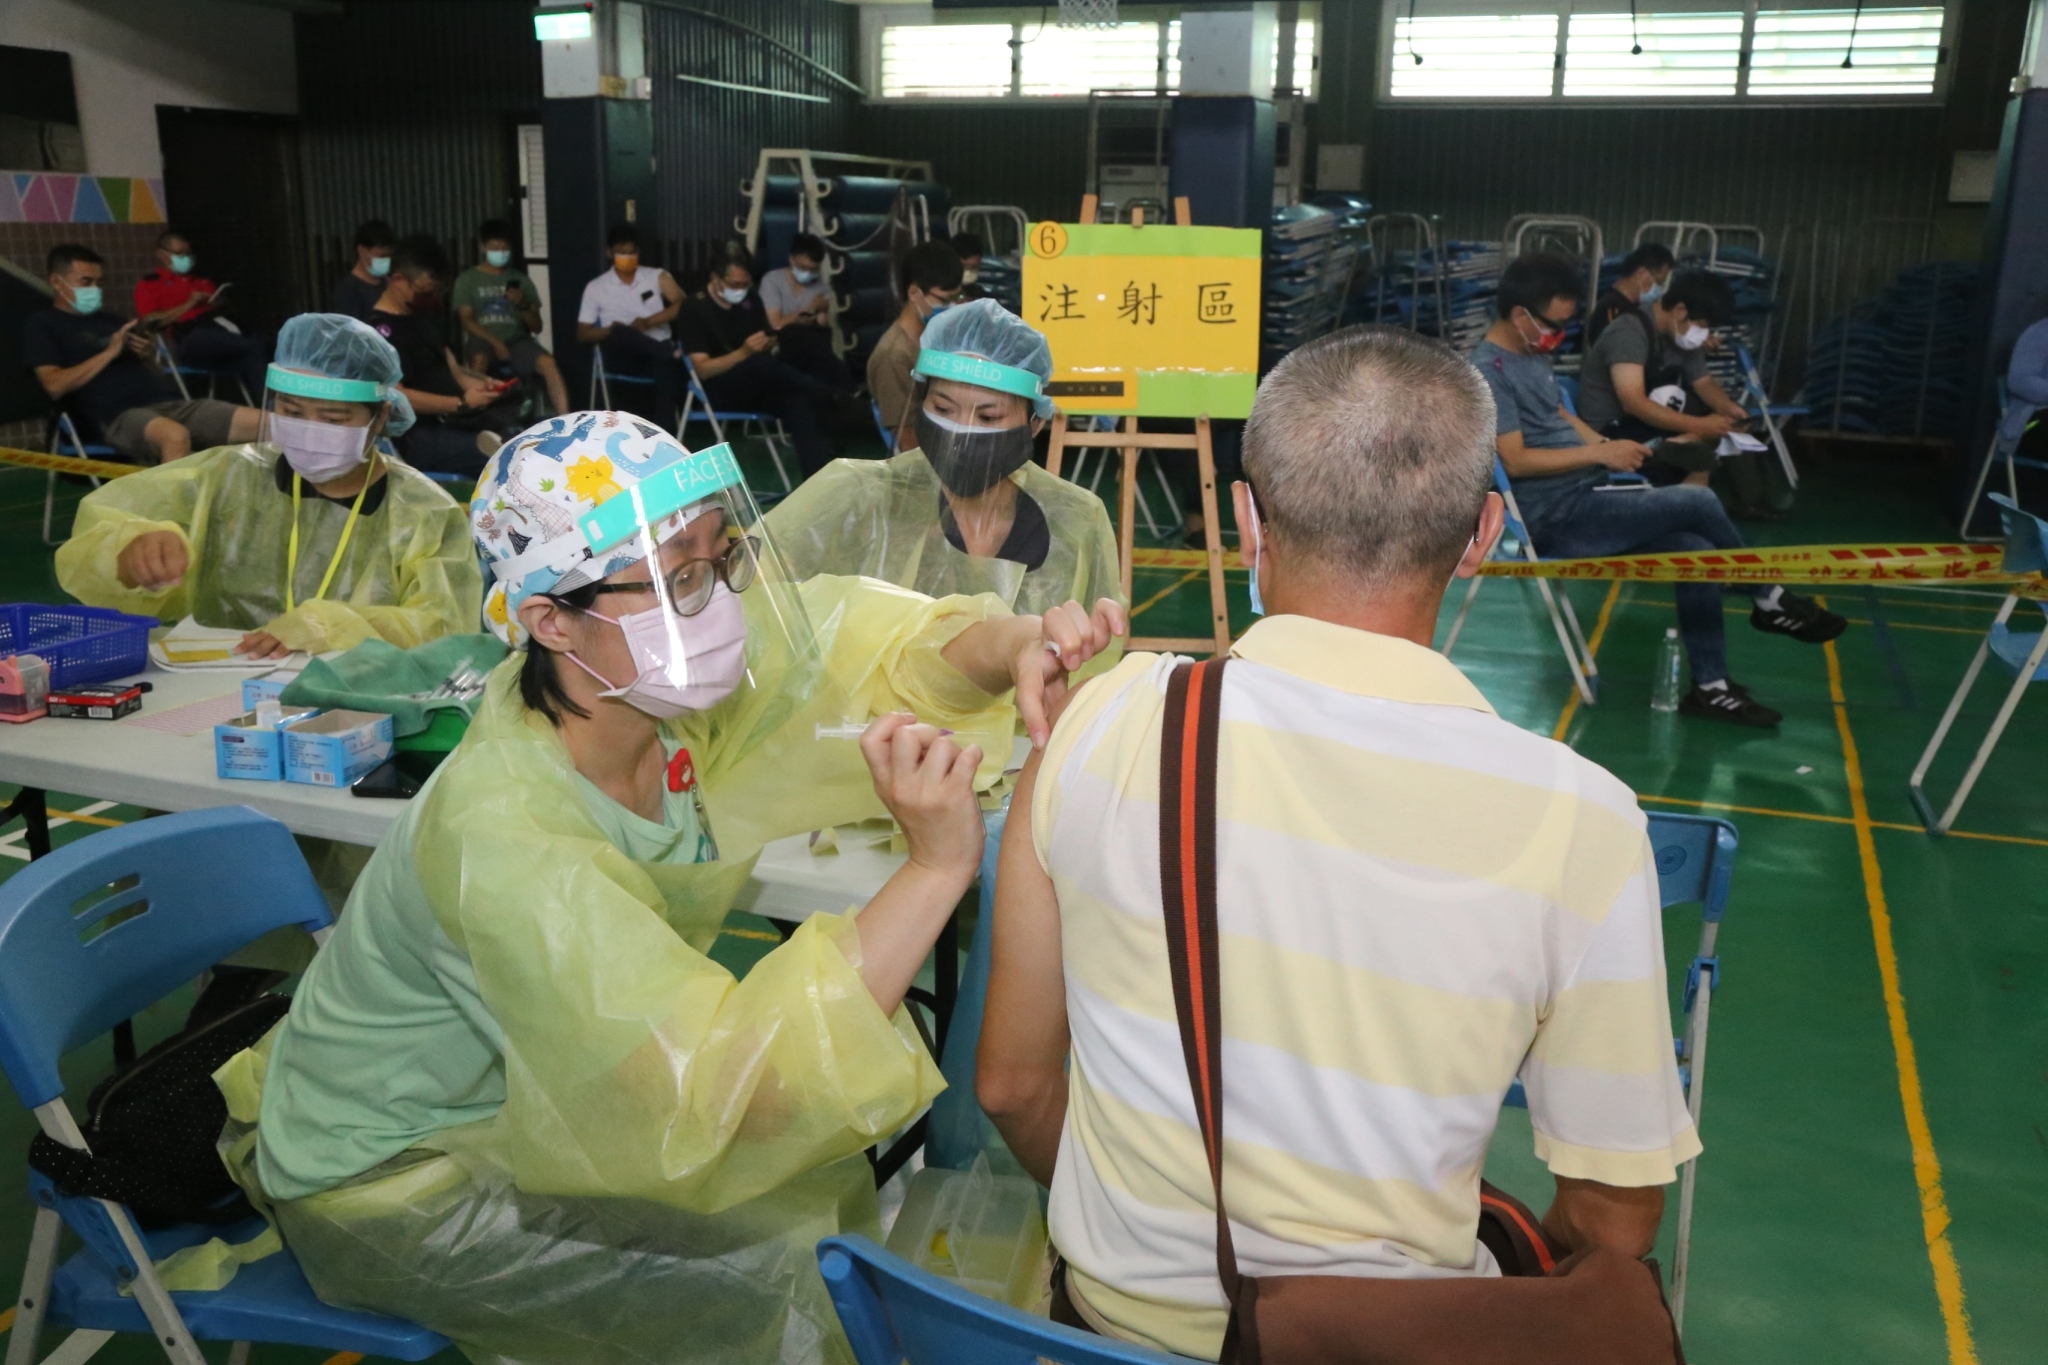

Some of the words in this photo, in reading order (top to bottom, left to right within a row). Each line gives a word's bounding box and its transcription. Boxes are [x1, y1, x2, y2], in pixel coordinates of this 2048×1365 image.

[1040, 225, 1057, 254] 6
[1039, 280, 1237, 326] 注射區
[923, 353, 949, 371] FACE
[951, 358, 1003, 382] SHIELD
[297, 378, 344, 395] SHIELD
[673, 455, 726, 493] FACE
